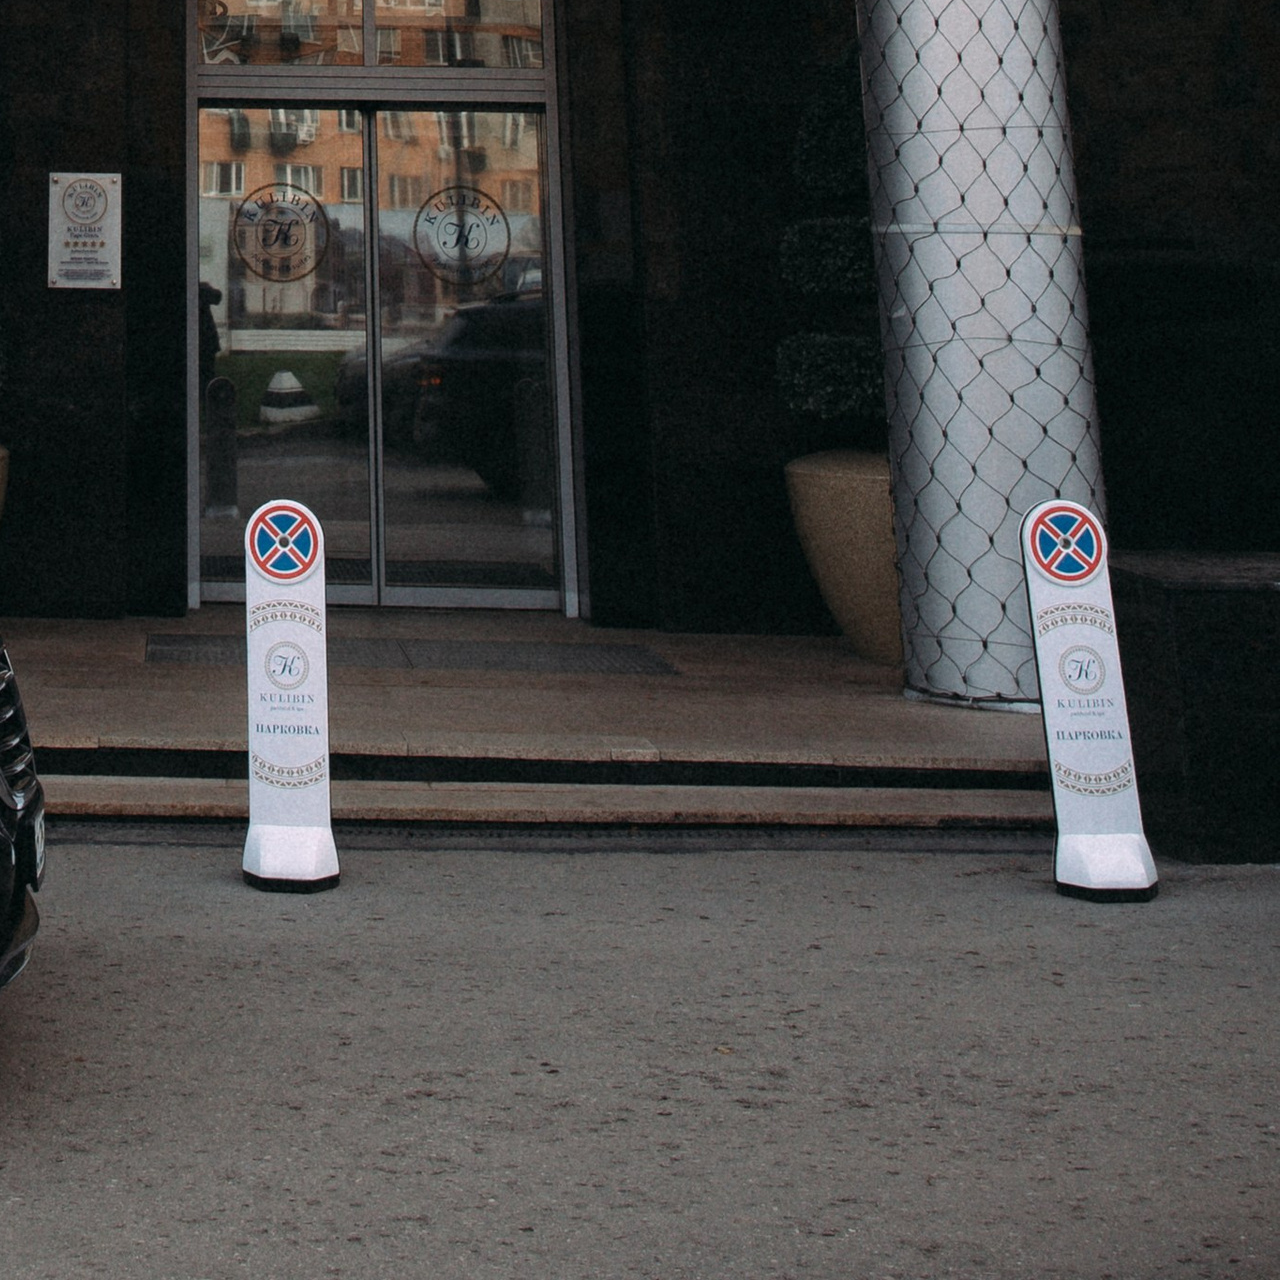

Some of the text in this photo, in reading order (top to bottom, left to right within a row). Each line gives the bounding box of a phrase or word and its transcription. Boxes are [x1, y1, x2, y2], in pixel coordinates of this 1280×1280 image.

[243, 190, 320, 224] KULIBIN
[424, 194, 501, 227] KULIBIN
[261, 218, 299, 247] K
[442, 222, 481, 250] K
[272, 655, 300, 677] K
[1068, 659, 1097, 681] K
[259, 693, 315, 704] KULIBIN
[1056, 697, 1114, 708] KULIBIN
[256, 723, 320, 735] ПАРКОВКА
[1056, 729, 1123, 741] ПАРКОВКА
